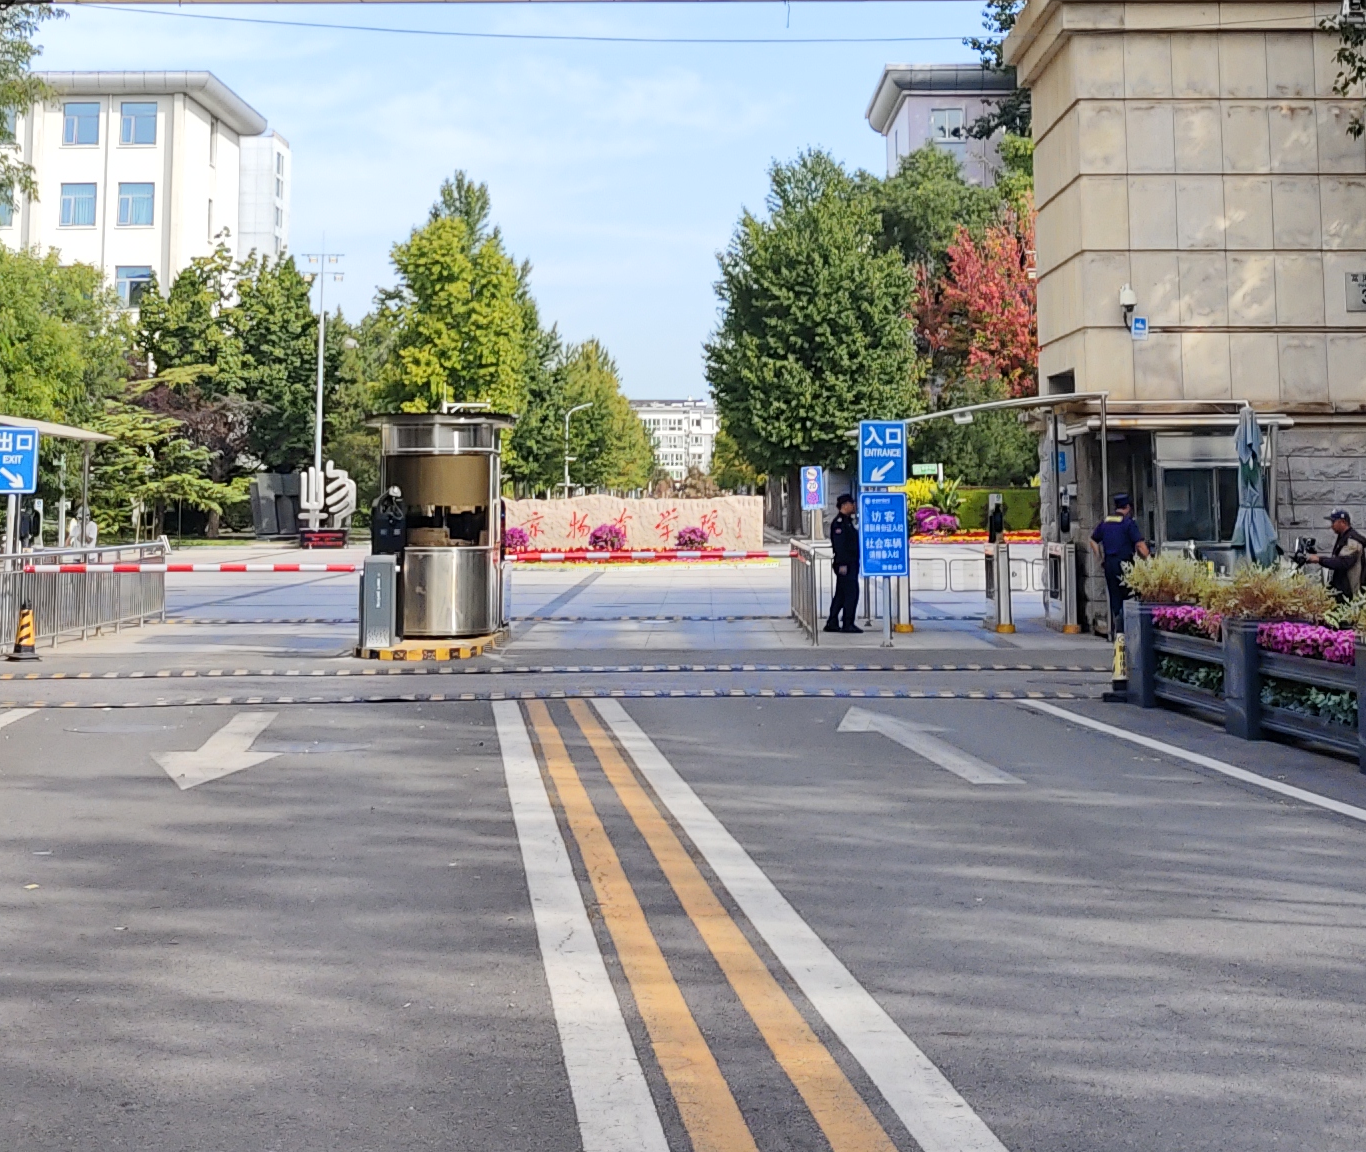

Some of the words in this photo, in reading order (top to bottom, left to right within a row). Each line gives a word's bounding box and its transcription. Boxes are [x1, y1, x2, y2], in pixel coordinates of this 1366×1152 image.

[864, 425, 902, 446] 入口
[864, 448, 902, 458] ENTRANCE
[2, 454, 23, 465] EXIT
[871, 510, 896, 523] 访客
[865, 537, 902, 549] 社会车辆
